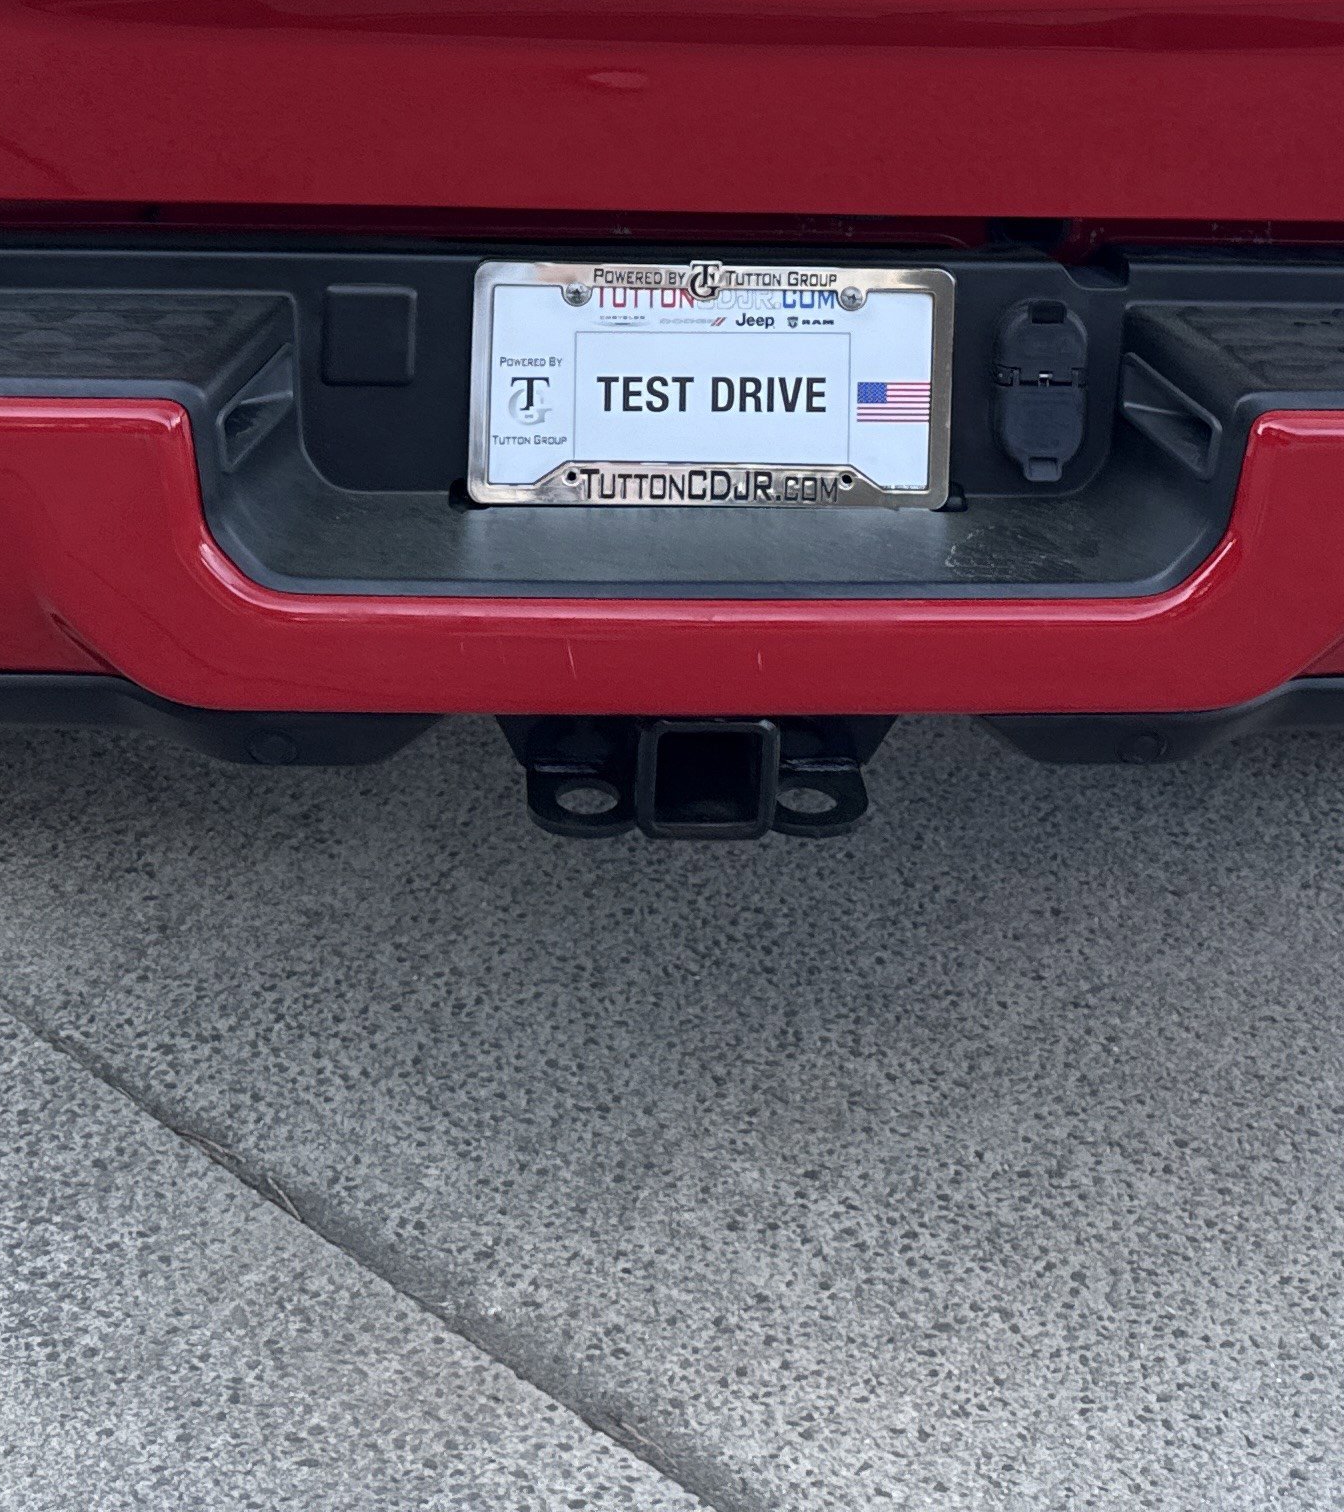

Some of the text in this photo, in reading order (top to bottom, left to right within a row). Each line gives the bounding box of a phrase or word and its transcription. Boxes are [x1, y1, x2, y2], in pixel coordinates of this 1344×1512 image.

[787, 271, 837, 287] GROUP
[735, 312, 775, 329] Jeep
[596, 376, 827, 413] TEST DRIVE
